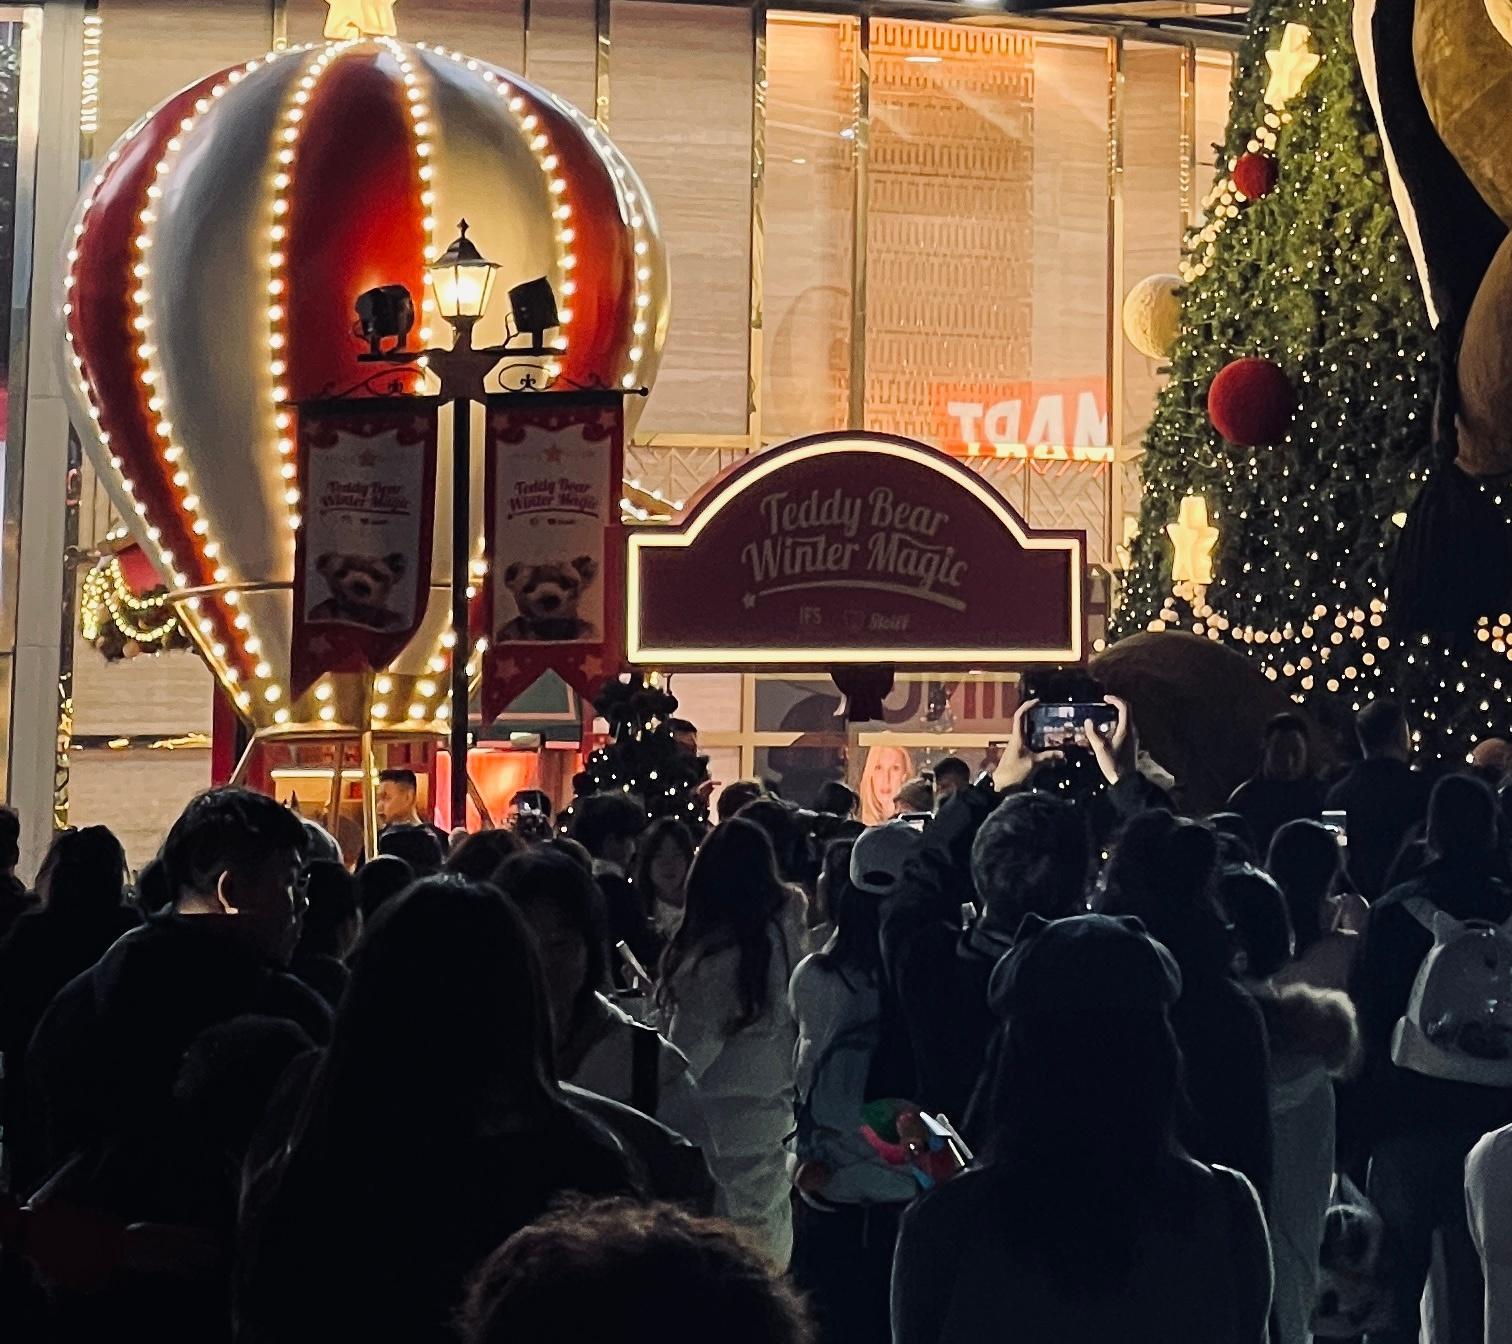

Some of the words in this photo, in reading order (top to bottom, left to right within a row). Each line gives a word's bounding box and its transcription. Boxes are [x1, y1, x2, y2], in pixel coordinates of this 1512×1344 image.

[760, 488, 862, 537] Teddy
[868, 486, 949, 536] Bear
[742, 534, 860, 581] Winter
[867, 531, 968, 591] Magic
